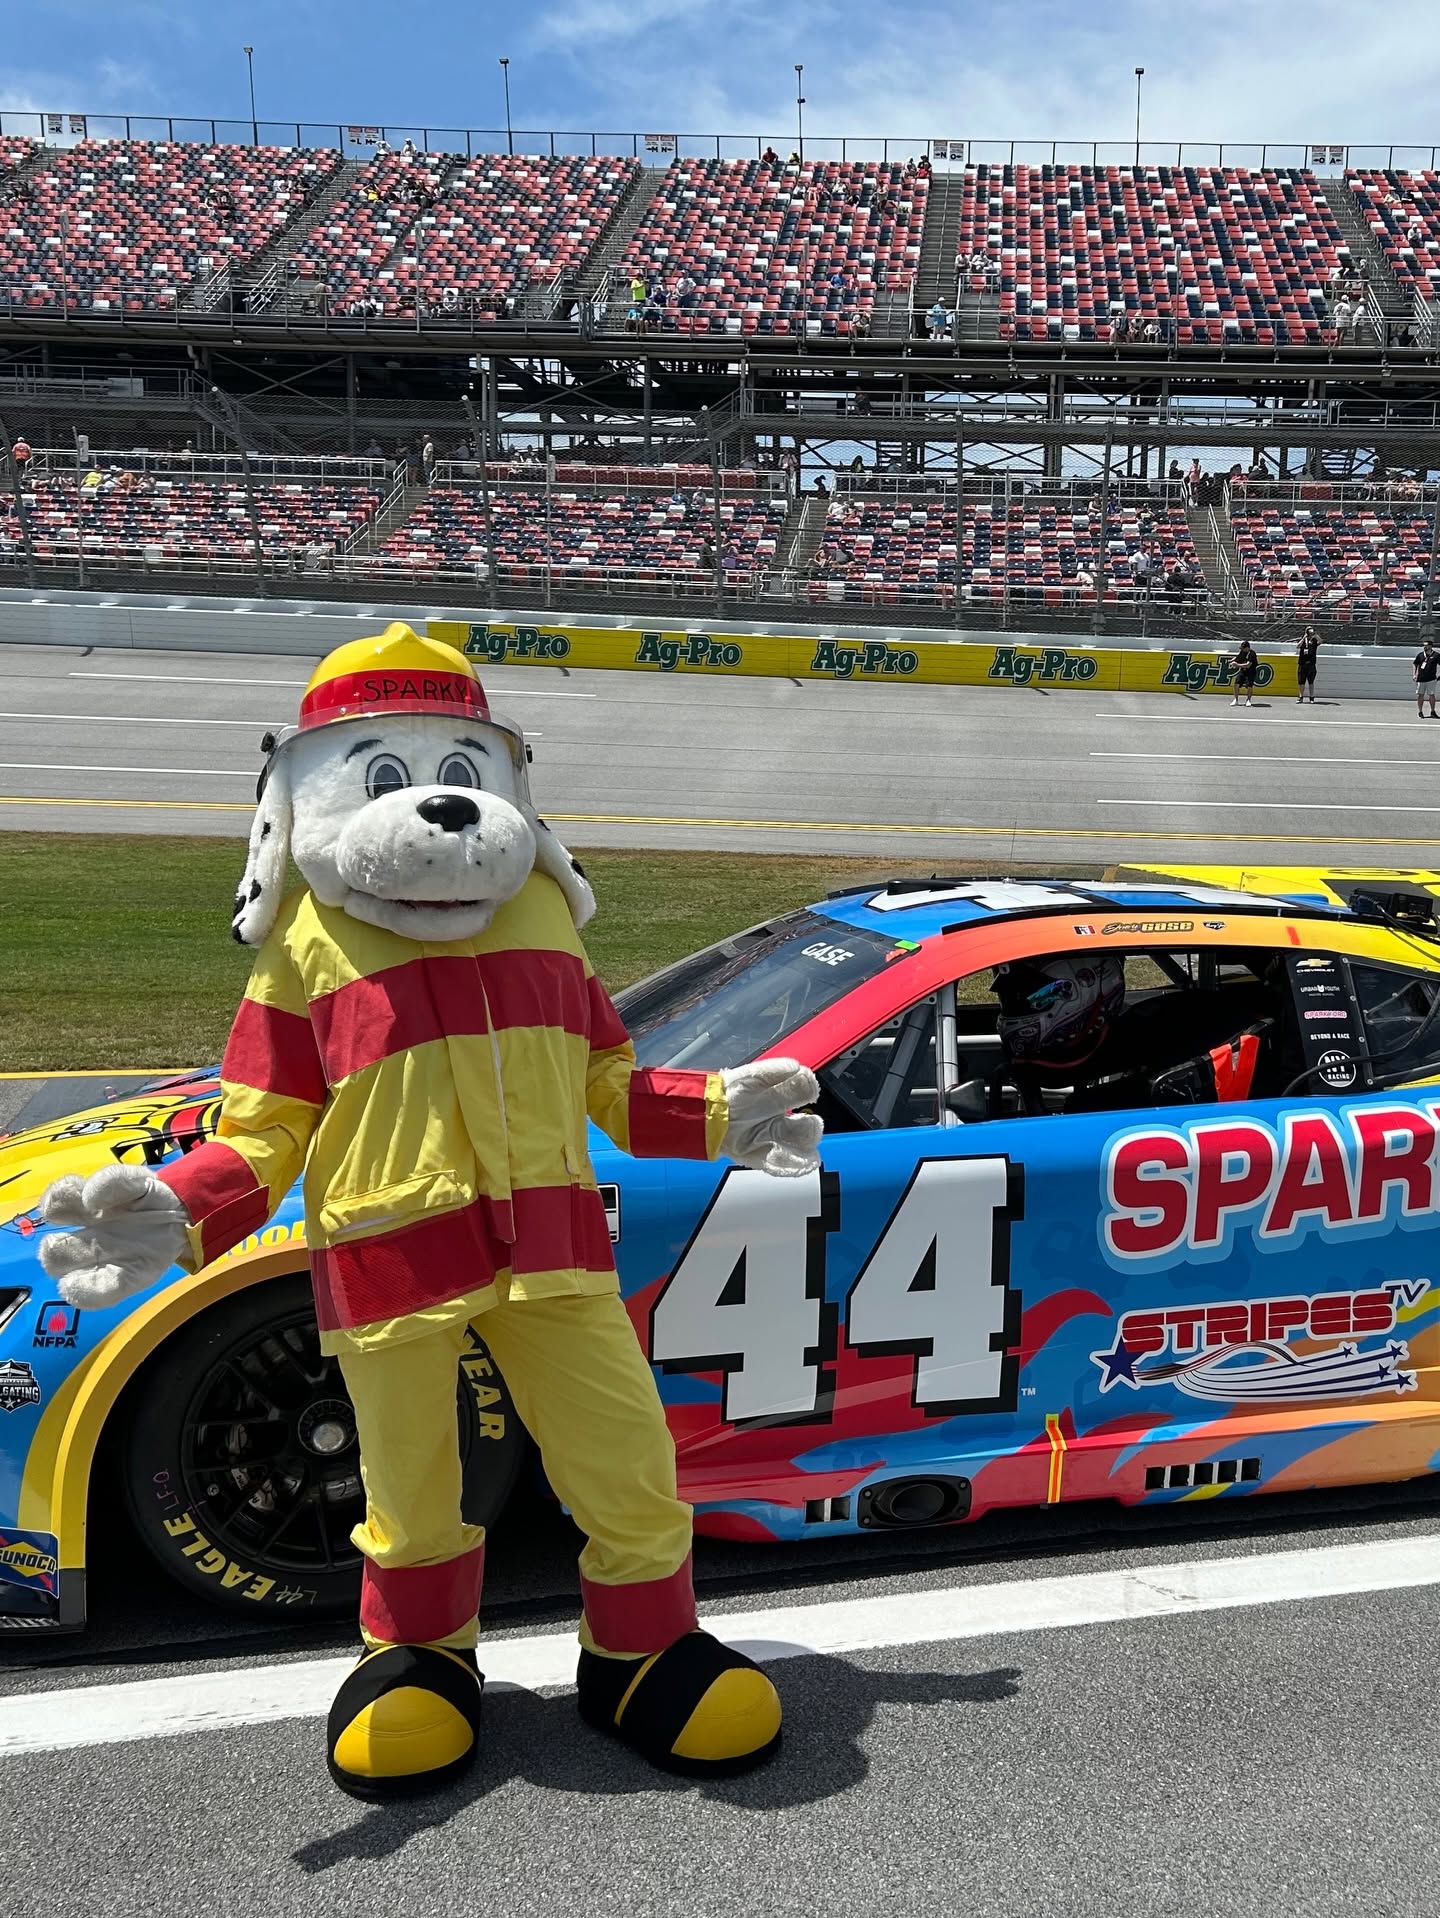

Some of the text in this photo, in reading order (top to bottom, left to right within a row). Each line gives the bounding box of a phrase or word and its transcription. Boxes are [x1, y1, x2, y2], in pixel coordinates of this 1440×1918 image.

[465, 624, 571, 663] Ag-Pro
[635, 631, 743, 671] Ag-Pro
[811, 639, 919, 678] Ag-Pro
[988, 646, 1098, 685] Ag-Pro
[1162, 653, 1275, 692] Ag-Po
[364, 678, 468, 704] SPARKY
[1105, 1104, 1440, 1257] SPAR
[650, 1154, 1025, 1428] 44
[1121, 1282, 1427, 1353] STRIPES TV
[33, 1336, 77, 1348] NFPA
[0, 1386, 39, 1402] GATING
[1021, 1387, 1037, 1397] TM
[163, 1512, 277, 1601] EAGLE
